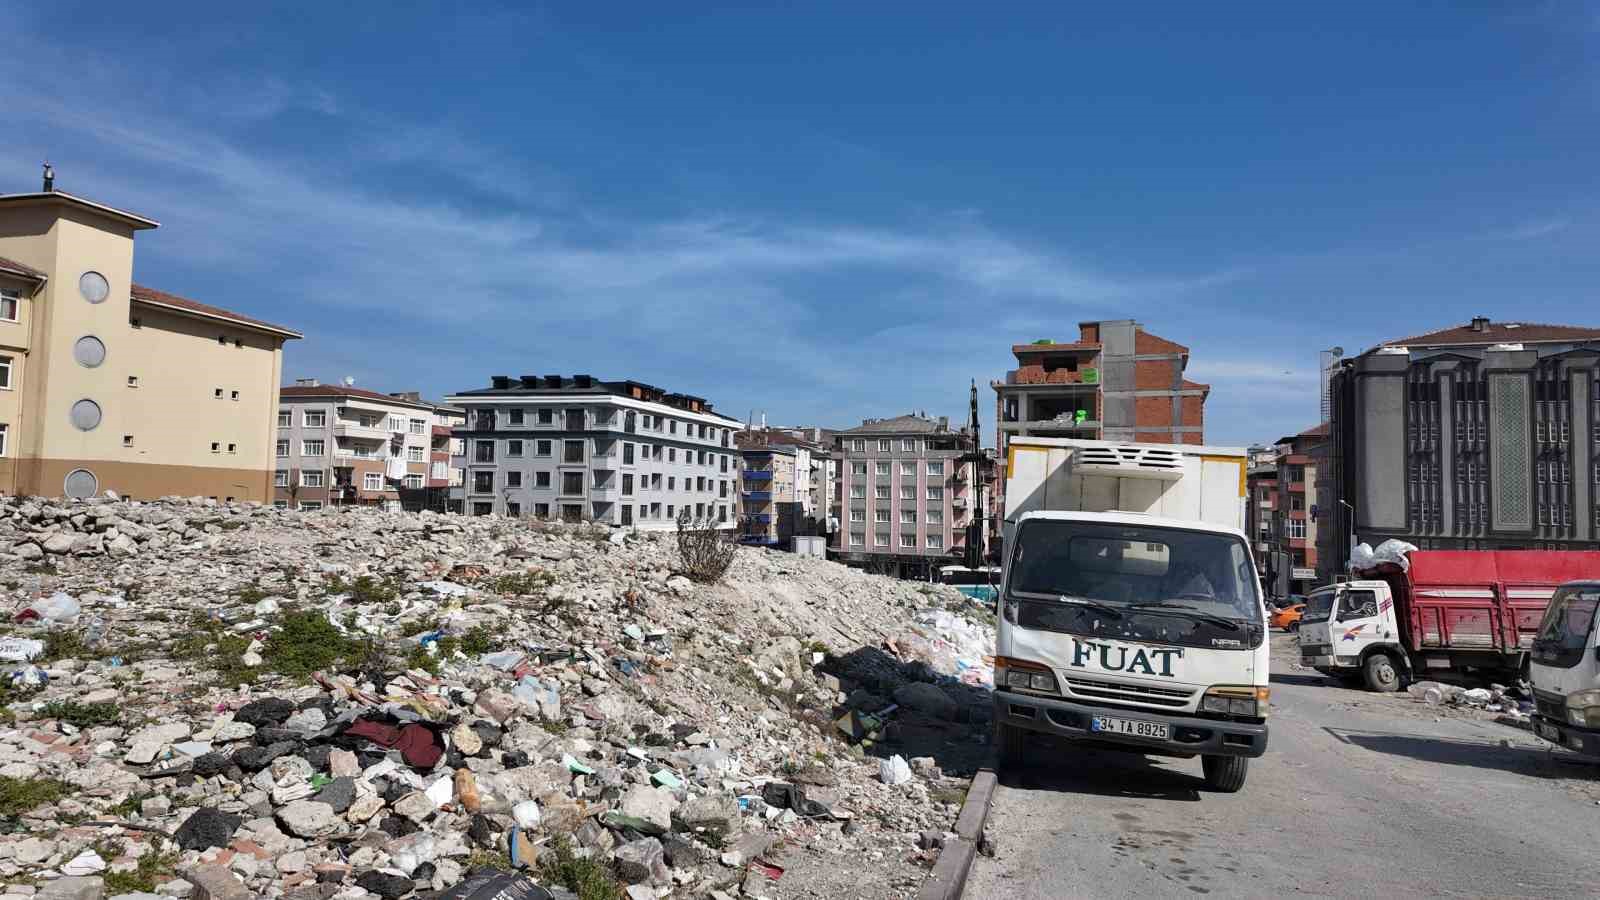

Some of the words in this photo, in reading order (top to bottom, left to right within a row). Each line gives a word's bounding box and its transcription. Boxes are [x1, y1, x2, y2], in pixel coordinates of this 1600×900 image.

[1071, 638, 1184, 677] FUAT
[1101, 718, 1114, 730] 34
[1120, 720, 1133, 733] TA
[1137, 723, 1166, 737] 8925
